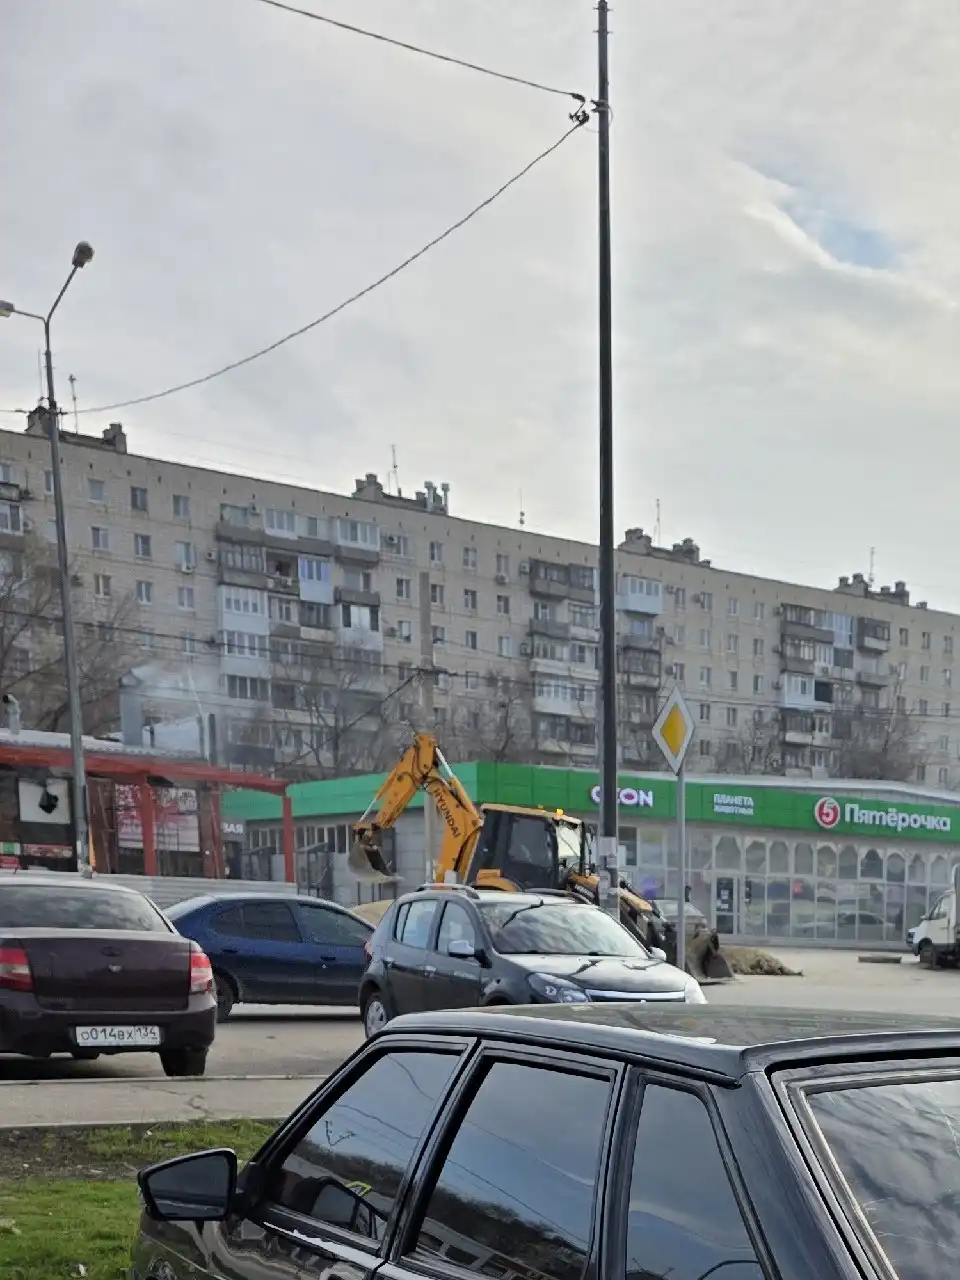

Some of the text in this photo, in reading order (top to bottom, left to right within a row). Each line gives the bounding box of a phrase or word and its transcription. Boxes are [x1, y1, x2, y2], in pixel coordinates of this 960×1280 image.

[433, 787, 461, 838] HYUNDAI
[713, 793, 754, 807] ПЛАНЕТА
[844, 803, 951, 831] Пятёрочка
